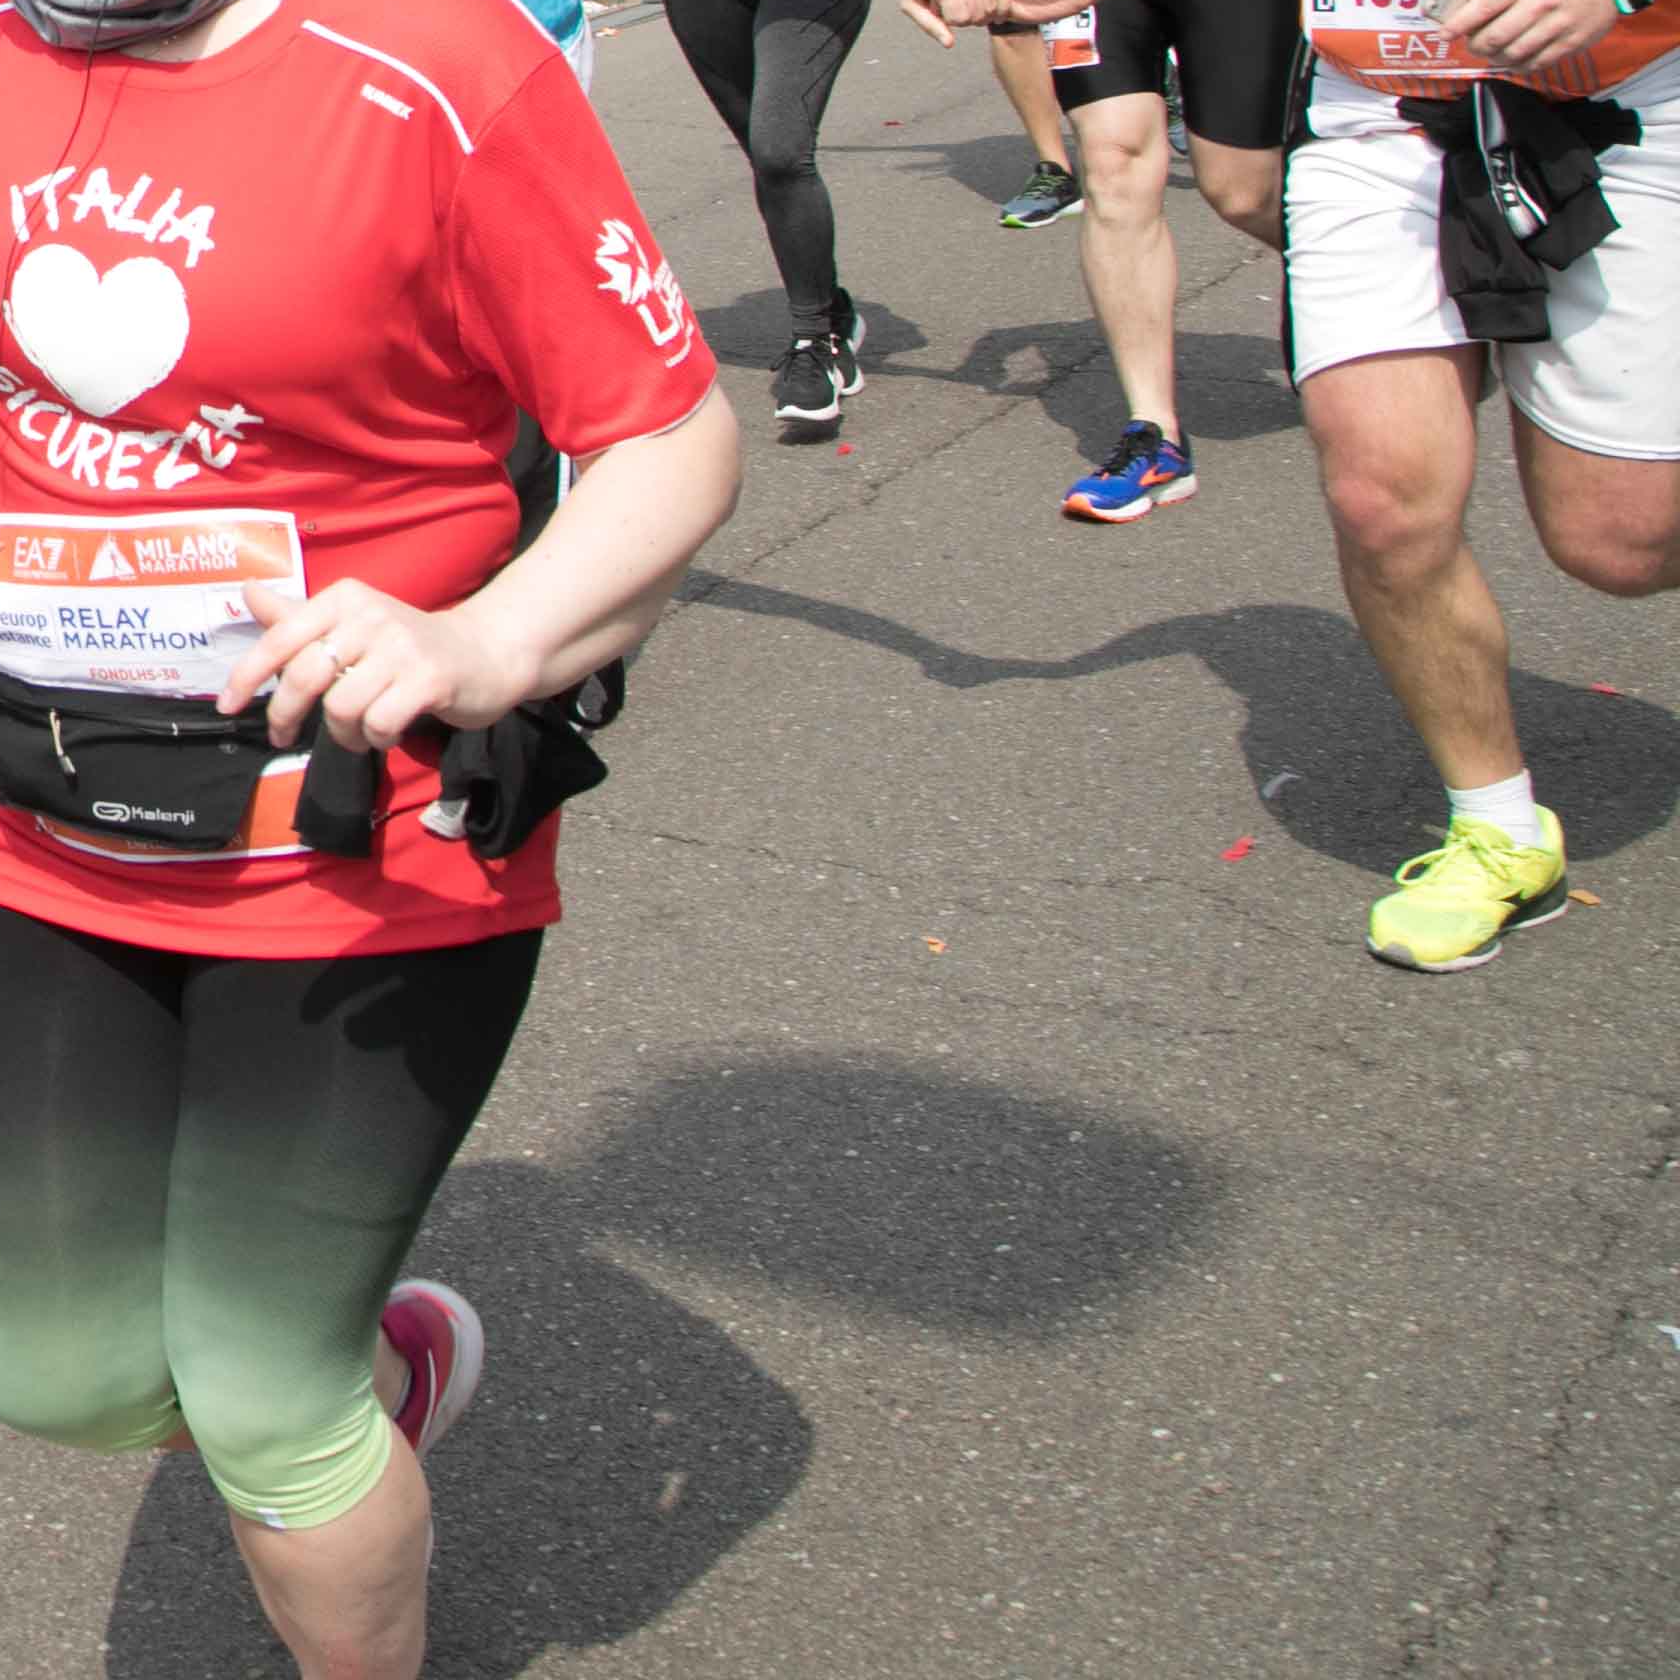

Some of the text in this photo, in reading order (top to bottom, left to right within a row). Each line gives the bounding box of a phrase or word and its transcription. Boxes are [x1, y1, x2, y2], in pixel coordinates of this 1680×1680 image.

[10, 166, 217, 269] ITALIA
[13, 531, 238, 570] EA7 MILANO
[137, 553, 238, 576] MARATHON
[0, 606, 151, 630] europ RELAY
[62, 631, 209, 650] MARATHON
[130, 805, 196, 825] Kalenji
